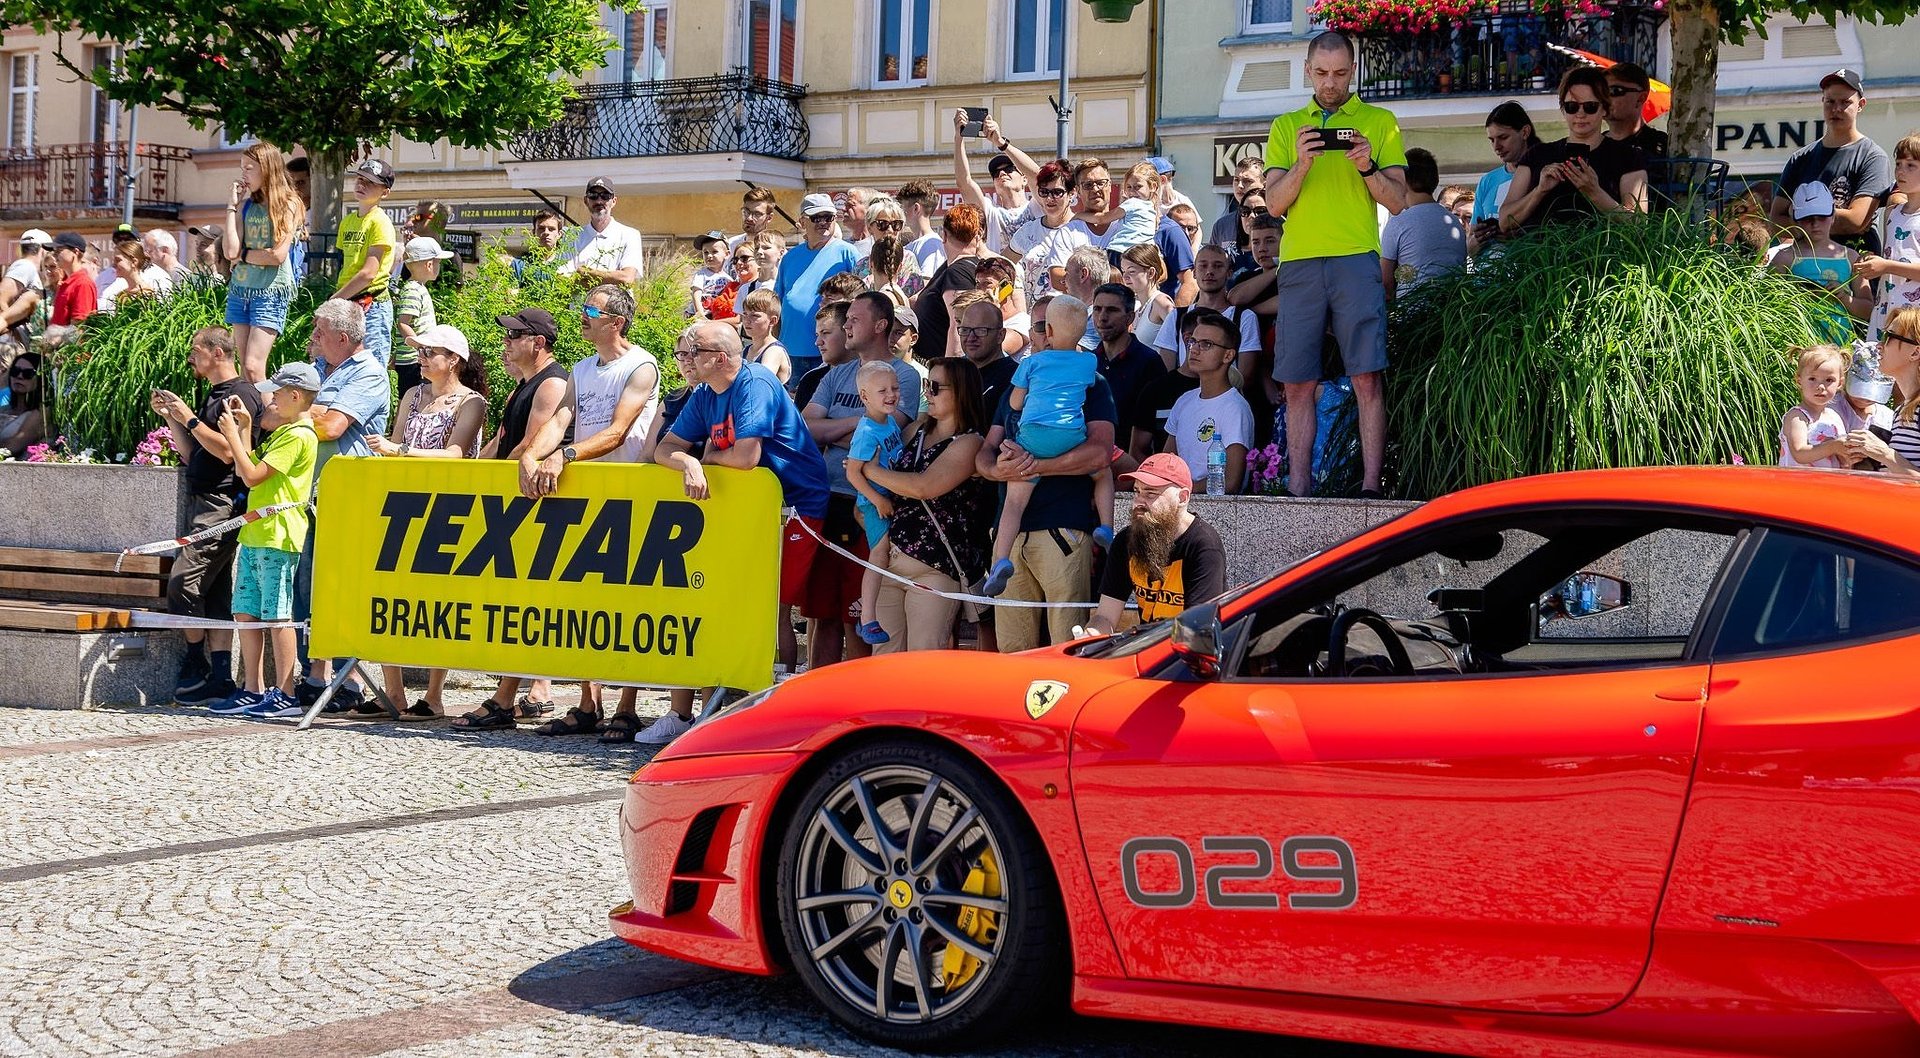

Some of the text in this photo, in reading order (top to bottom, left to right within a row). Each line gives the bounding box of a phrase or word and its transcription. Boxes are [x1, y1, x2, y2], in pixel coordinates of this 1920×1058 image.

[445, 233, 473, 244] PIZZERIA
[460, 210, 480, 218] PIZZA
[483, 209, 520, 217] MAKARONY
[375, 491, 705, 588] TEXTAR
[370, 596, 702, 657] BRAKE TECHNOLOGY
[1120, 835, 1358, 910] 029
